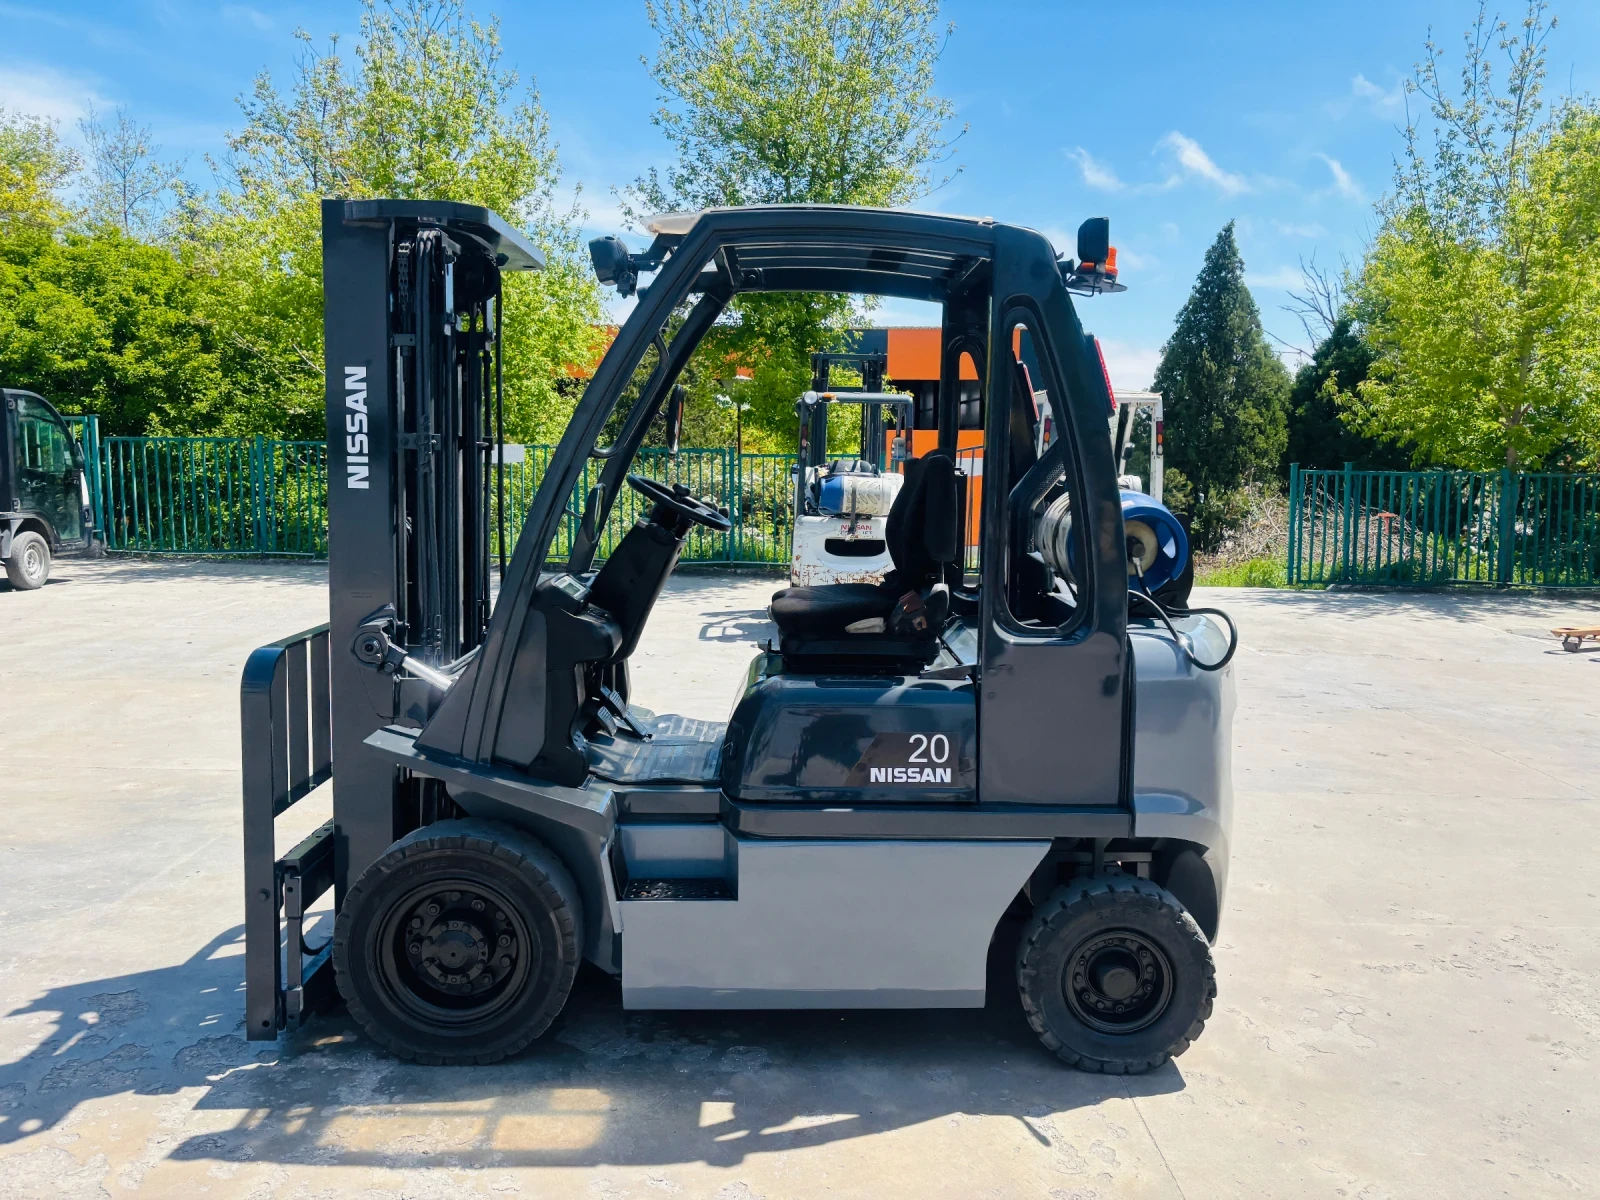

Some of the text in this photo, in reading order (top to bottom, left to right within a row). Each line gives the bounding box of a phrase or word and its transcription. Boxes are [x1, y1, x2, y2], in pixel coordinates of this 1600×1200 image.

[344, 366, 370, 489] NISSAN
[908, 733, 950, 763] 20
[870, 767, 952, 783] NISSAN
